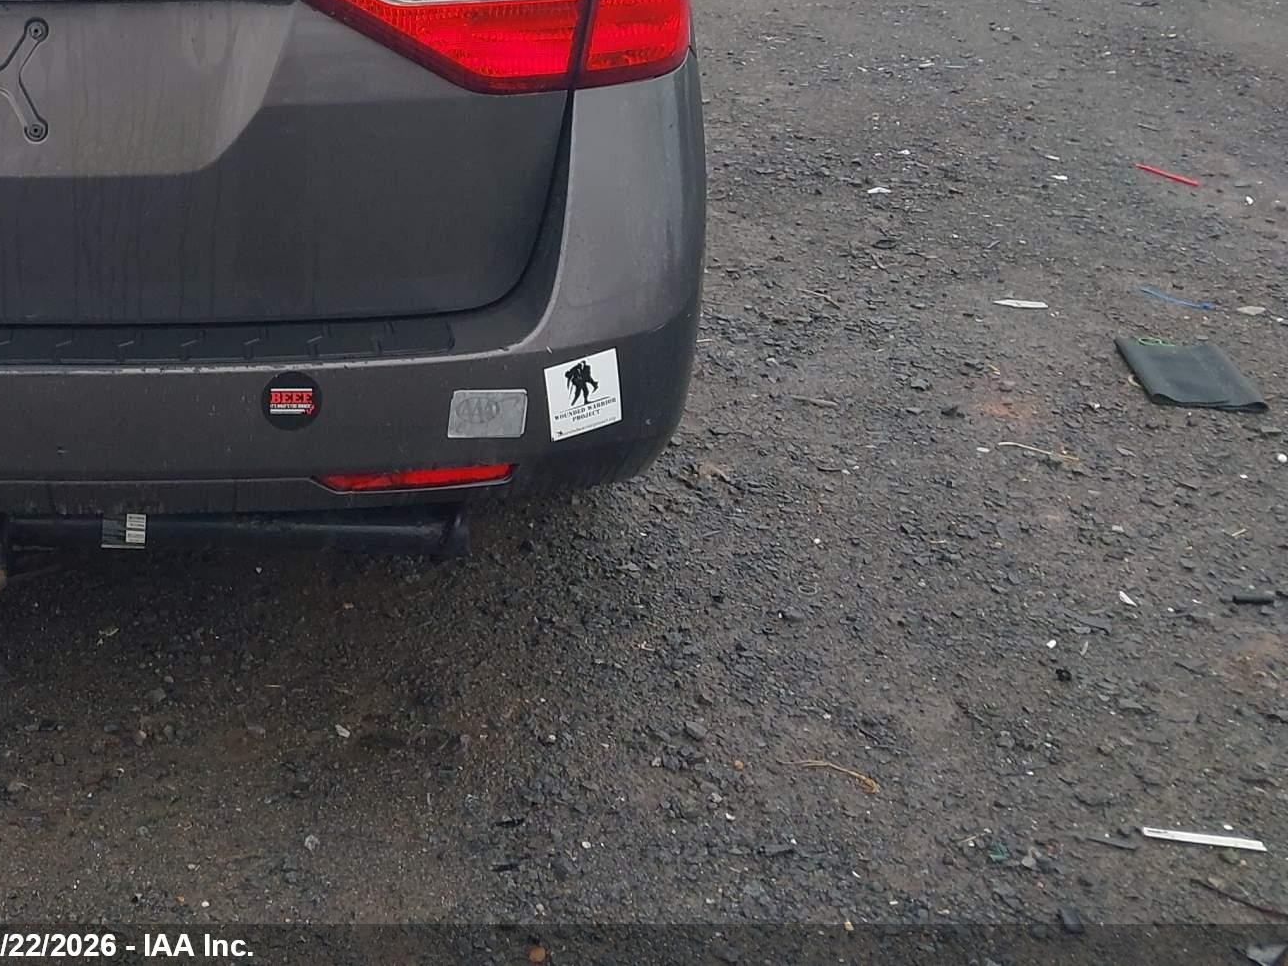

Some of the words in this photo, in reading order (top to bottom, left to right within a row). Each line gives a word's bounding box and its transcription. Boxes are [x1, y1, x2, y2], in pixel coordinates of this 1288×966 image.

[554, 408, 586, 420] WOUNDED
[587, 397, 616, 410] WARRIOR
[572, 409, 600, 422] PROJECT
